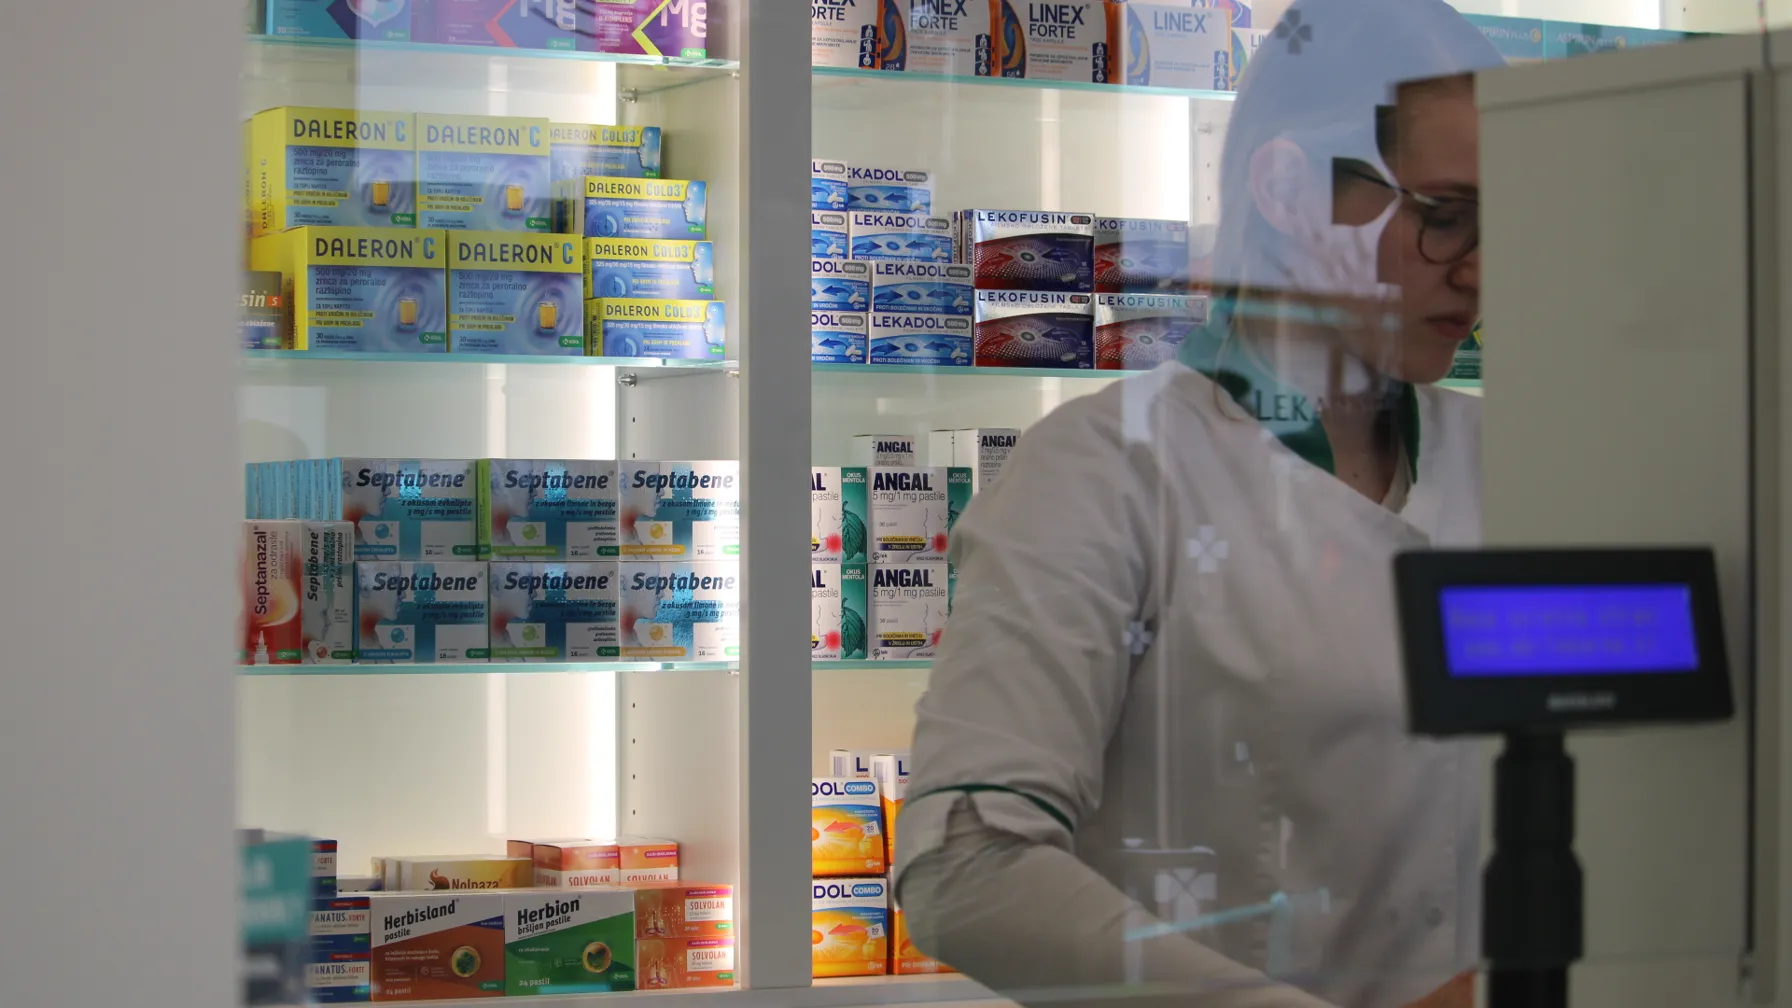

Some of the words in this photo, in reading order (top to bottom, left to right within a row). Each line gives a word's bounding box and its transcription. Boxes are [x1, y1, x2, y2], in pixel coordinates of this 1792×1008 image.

[1028, 3, 1085, 25] LINEX
[910, 16, 959, 31] FORTE
[1153, 10, 1208, 34] LINEX
[1029, 25, 1076, 39] FORTE
[293, 118, 386, 142] DALERON
[394, 120, 406, 143] C
[426, 124, 520, 147] DALERON
[529, 126, 540, 148] C
[848, 168, 904, 182] KADOL
[588, 182, 641, 195] DALERON
[854, 214, 925, 229] LEKADOL
[978, 212, 1066, 224] LEKOFUSIN
[316, 238, 413, 259] DALERON
[423, 237, 435, 260] C
[458, 242, 552, 264] DALERON
[562, 242, 574, 264] C
[595, 244, 648, 257] DALERON
[876, 264, 946, 277] LEKADOL
[339, 278, 349, 286] za
[350, 278, 386, 288] peroralno
[492, 282, 527, 292] peroralno
[316, 286, 352, 296] raztopino
[978, 292, 1066, 304] LEKOFUSIN
[1098, 295, 1182, 308] LEKOFUSIN
[606, 304, 660, 318] DALERON
[873, 316, 944, 330] LEKADOL
[876, 442, 914, 454] ANGAL
[356, 468, 465, 492] Septabene
[504, 470, 609, 493] Septabene
[632, 470, 734, 493] Septabene
[873, 472, 933, 492] ANGAL
[812, 491, 839, 503] pastile
[872, 492, 878, 501] 5
[880, 491, 901, 504] mg/1
[902, 493, 918, 504] mg
[918, 491, 946, 504] pastile
[254, 532, 270, 615] Septanazal
[874, 568, 933, 588] ANGAL
[372, 572, 478, 596] Septabene
[504, 572, 609, 596] Septabene
[630, 572, 736, 596] Septabene
[812, 588, 839, 598] pastile
[872, 588, 878, 598] 5
[880, 588, 902, 600] mg/1
[903, 590, 918, 600] mg
[918, 587, 946, 600] pastile
[845, 784, 874, 792] COMBO
[814, 884, 852, 899] DOL
[853, 886, 882, 895] COMBO
[517, 898, 580, 926] Herbion
[690, 900, 726, 910] SOLVOLAN
[314, 913, 346, 922] ANATUS
[384, 900, 456, 931] Herbisland
[518, 918, 544, 936] bršljan
[546, 914, 572, 928] pastile
[384, 928, 412, 943] pastile
[692, 952, 727, 961] SOLVOLAN
[529, 976, 550, 987] pastil
